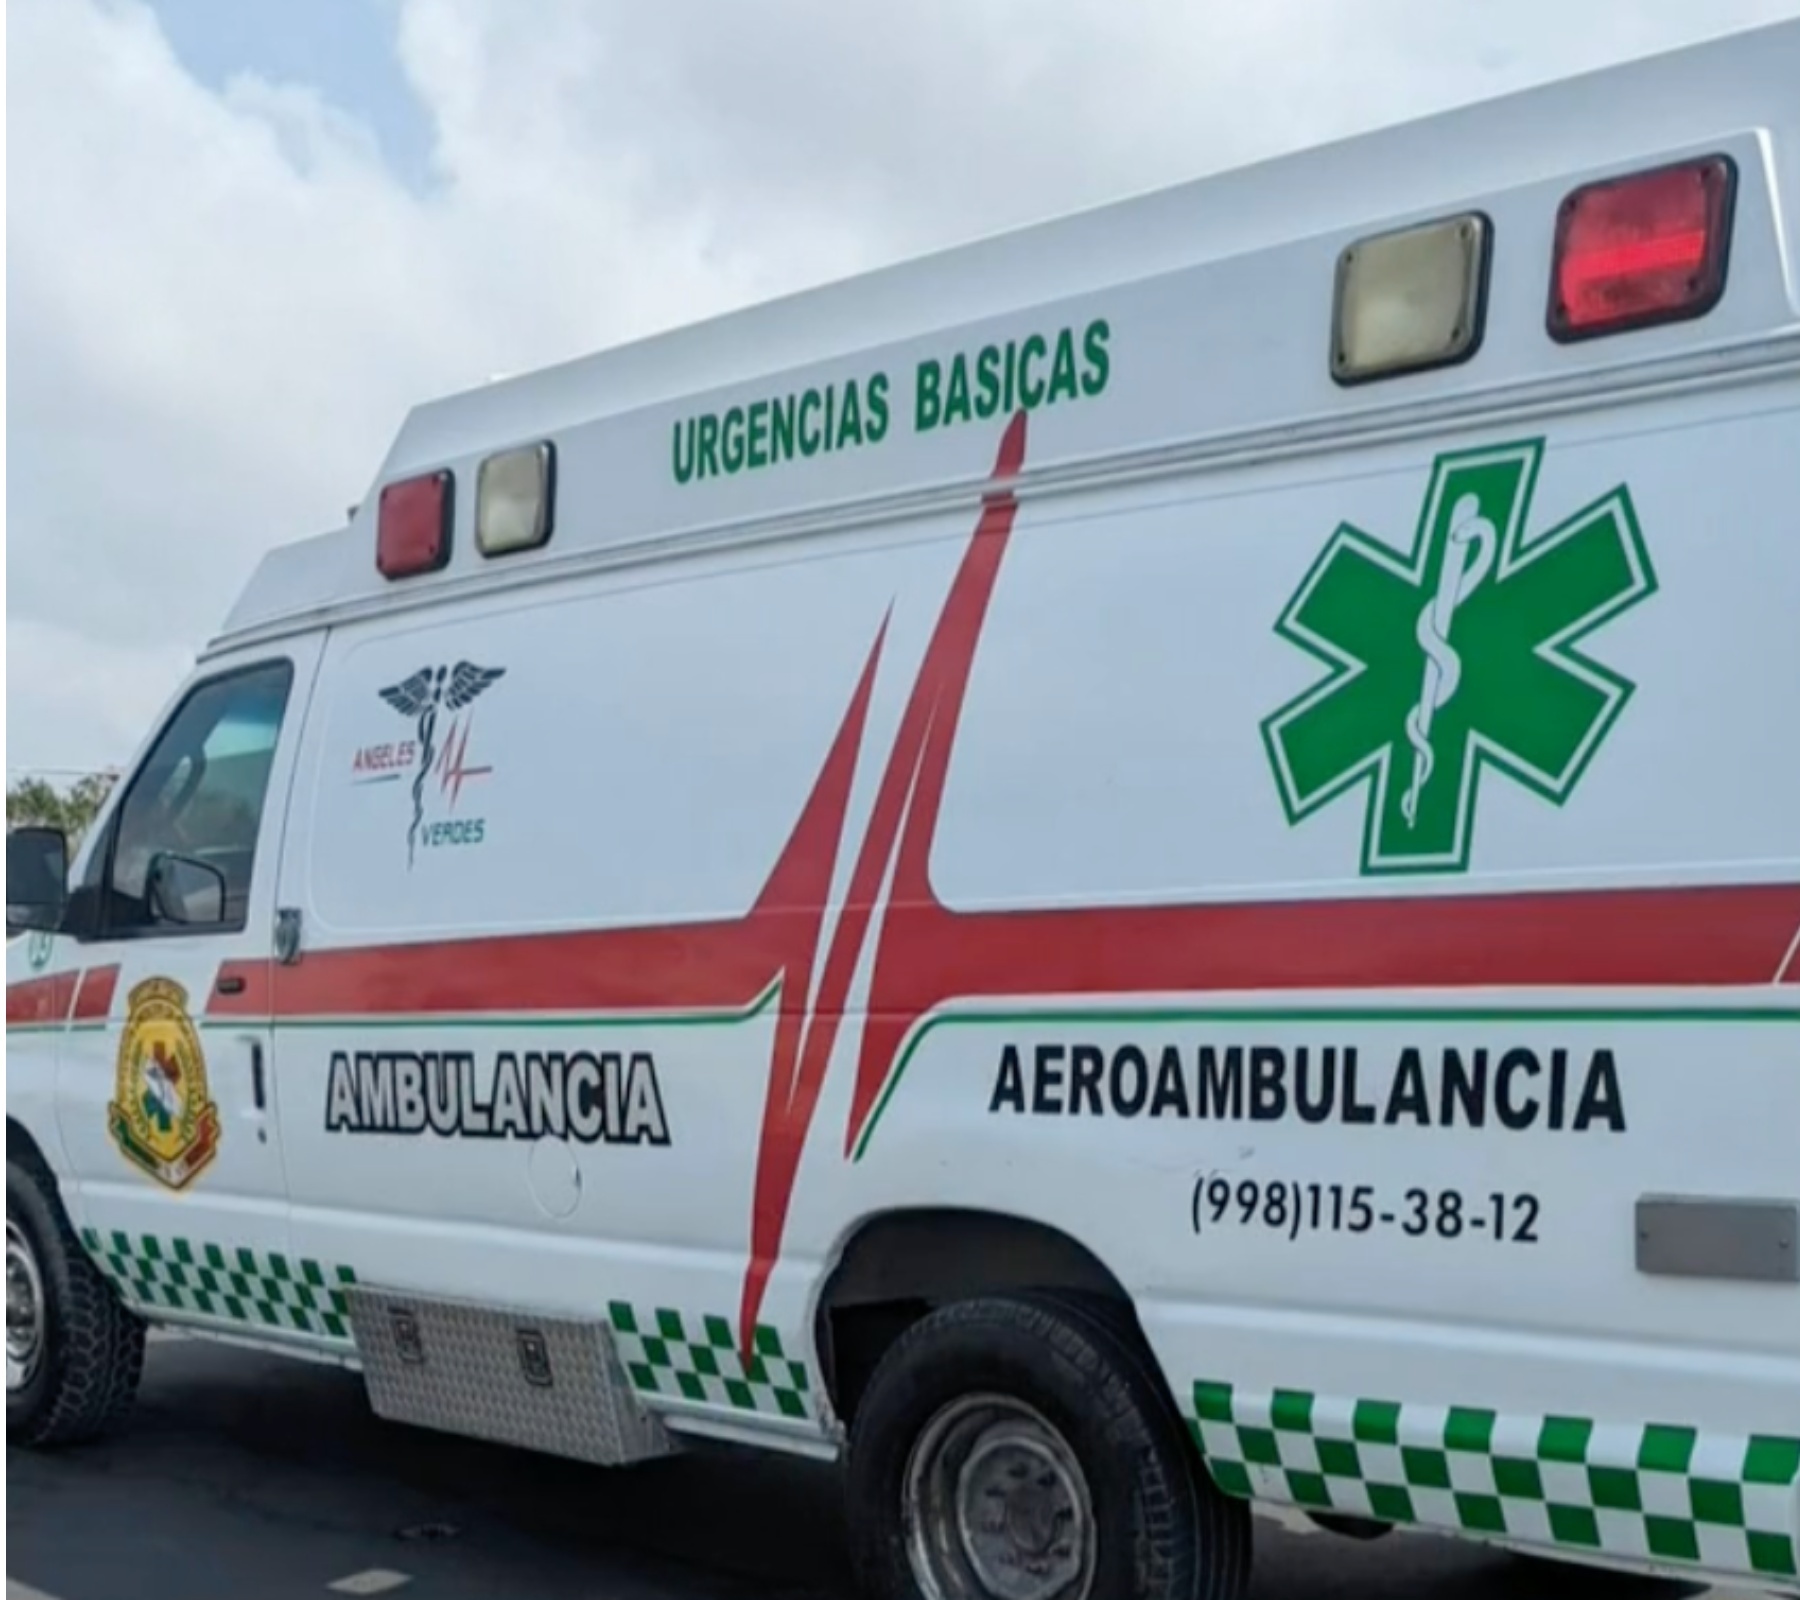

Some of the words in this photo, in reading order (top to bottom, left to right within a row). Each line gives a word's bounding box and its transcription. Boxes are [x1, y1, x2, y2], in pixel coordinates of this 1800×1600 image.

[671, 372, 890, 485] URGENCIAS
[914, 318, 1111, 435] BASICAS
[352, 739, 416, 772] ANGELES
[421, 818, 485, 847] VERDES
[325, 1050, 672, 1147] AMBULANCIA
[989, 1044, 1626, 1132] AEROAMBULANCIA
[1192, 1177, 1539, 1243] (998)115-38-12
